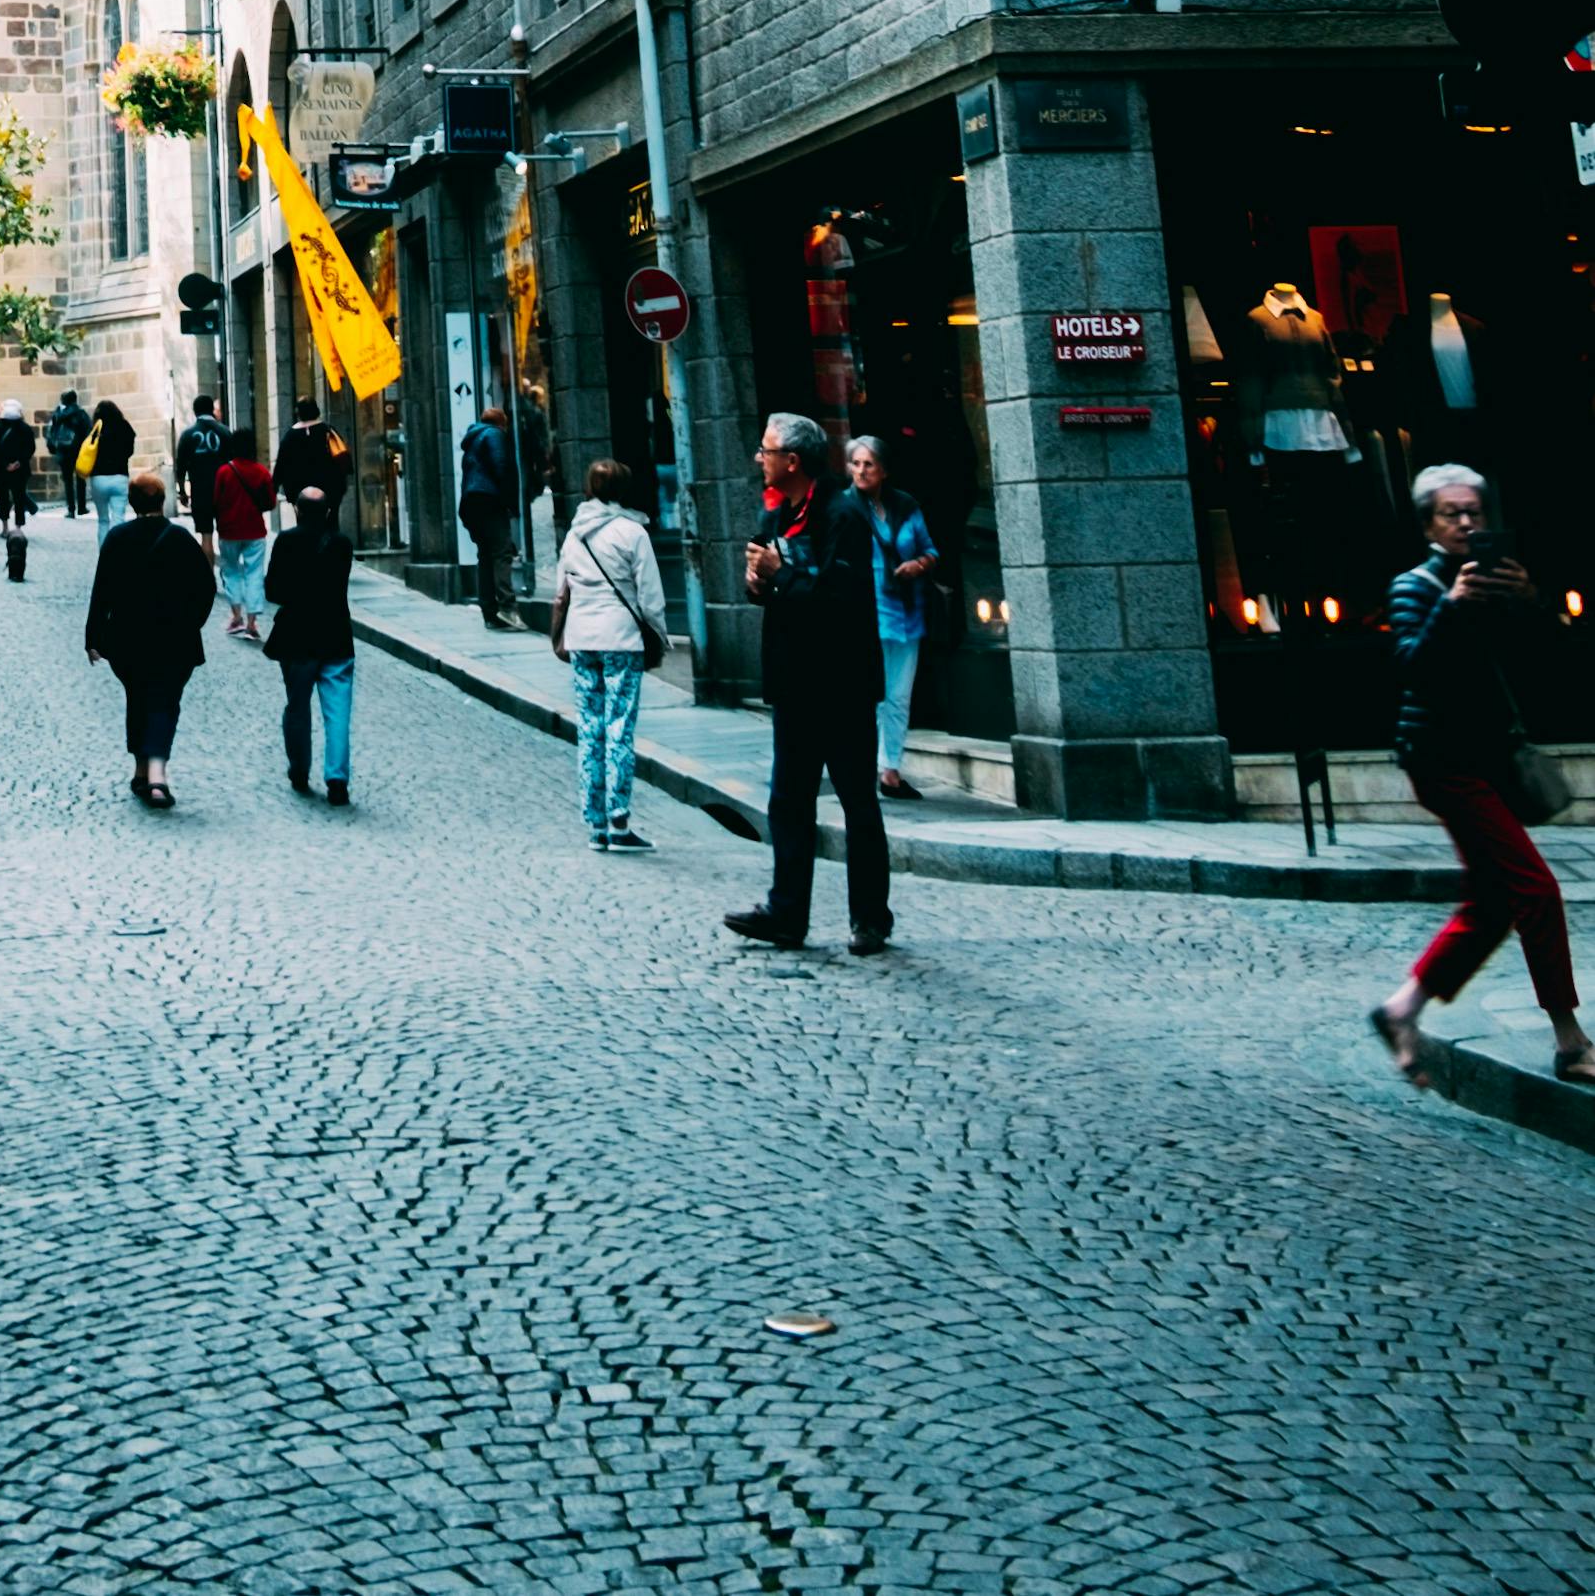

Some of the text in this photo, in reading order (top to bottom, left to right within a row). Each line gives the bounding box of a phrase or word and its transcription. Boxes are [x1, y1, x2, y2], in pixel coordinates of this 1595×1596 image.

[322, 83, 353, 97] CINQ
[302, 99, 362, 110] SEMAINES
[318, 114, 333, 126] EN
[1039, 108, 1107, 124] MERCIERS
[300, 130, 348, 141] BALLON
[453, 128, 508, 139] AGATHA
[1056, 316, 1123, 337] HOTELS
[1057, 345, 1132, 359] LE CROISEUR
[1064, 414, 1132, 423] BRISTOL UNION
[192, 430, 220, 453] 20
